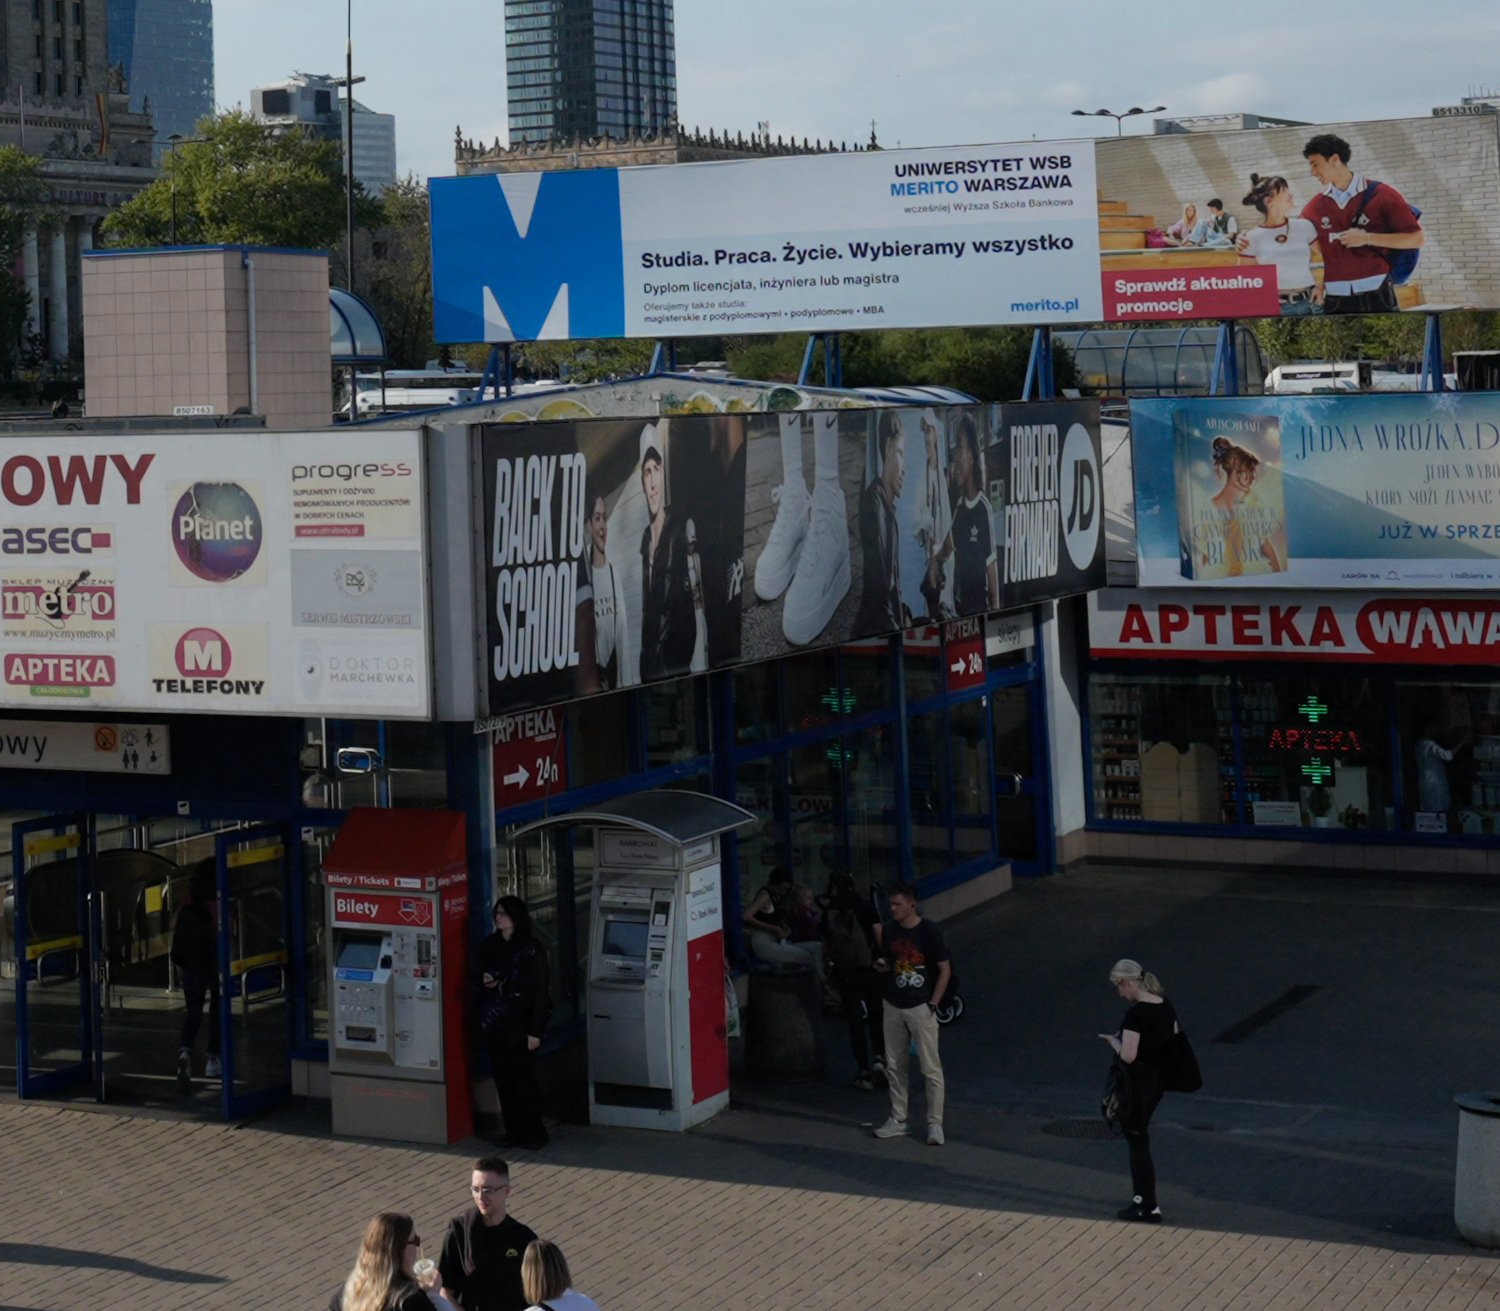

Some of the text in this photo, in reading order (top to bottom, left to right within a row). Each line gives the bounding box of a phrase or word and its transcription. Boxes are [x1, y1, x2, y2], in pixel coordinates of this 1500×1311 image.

[894, 154, 1072, 178] UNIWERSYTET WSB
[890, 174, 1072, 197] MERITO WARSZAWA
[904, 197, 1074, 215] wcześniej Wyższa Szkoła Bankowa
[641, 234, 1074, 269] Studia. Praca. Życie. Wybieramy wszystko
[644, 272, 899, 296] Dyplom licencjata, inżyniera lub magistra
[1114, 275, 1264, 296] Sprawdź aktualne
[863, 305, 885, 314] MBA
[1011, 298, 1080, 313] merito.pl
[1116, 298, 1193, 316] promocje
[1296, 424, 1364, 460] JEDNA
[292, 463, 412, 482] progress
[1010, 423, 1059, 504] FOREVER
[1067, 459, 1095, 535] JD
[492, 452, 587, 568] BACK TO
[179, 515, 253, 541] Planet
[1378, 520, 1412, 539] JUŻ
[1417, 524, 1439, 538] W
[2, 527, 93, 555] asec
[1004, 499, 1059, 585] FORWARD
[47, 578, 116, 586] MUZCZNY
[3, 586, 113, 616] metro
[493, 561, 579, 682] SCHOOL
[944, 620, 980, 642] APTEKA
[1119, 603, 1345, 648] APTEKA
[183, 640, 223, 671] M
[329, 656, 414, 671] DOKTOR
[9, 657, 111, 683] APTEKA
[329, 672, 415, 684] MARCHEWKA
[152, 678, 265, 695] TELEFONY
[494, 709, 557, 745] APTEKA
[1268, 728, 1362, 750] APTEKA
[328, 874, 353, 886] Bilety
[358, 876, 389, 886] Tickets
[336, 898, 379, 919] Bilety
